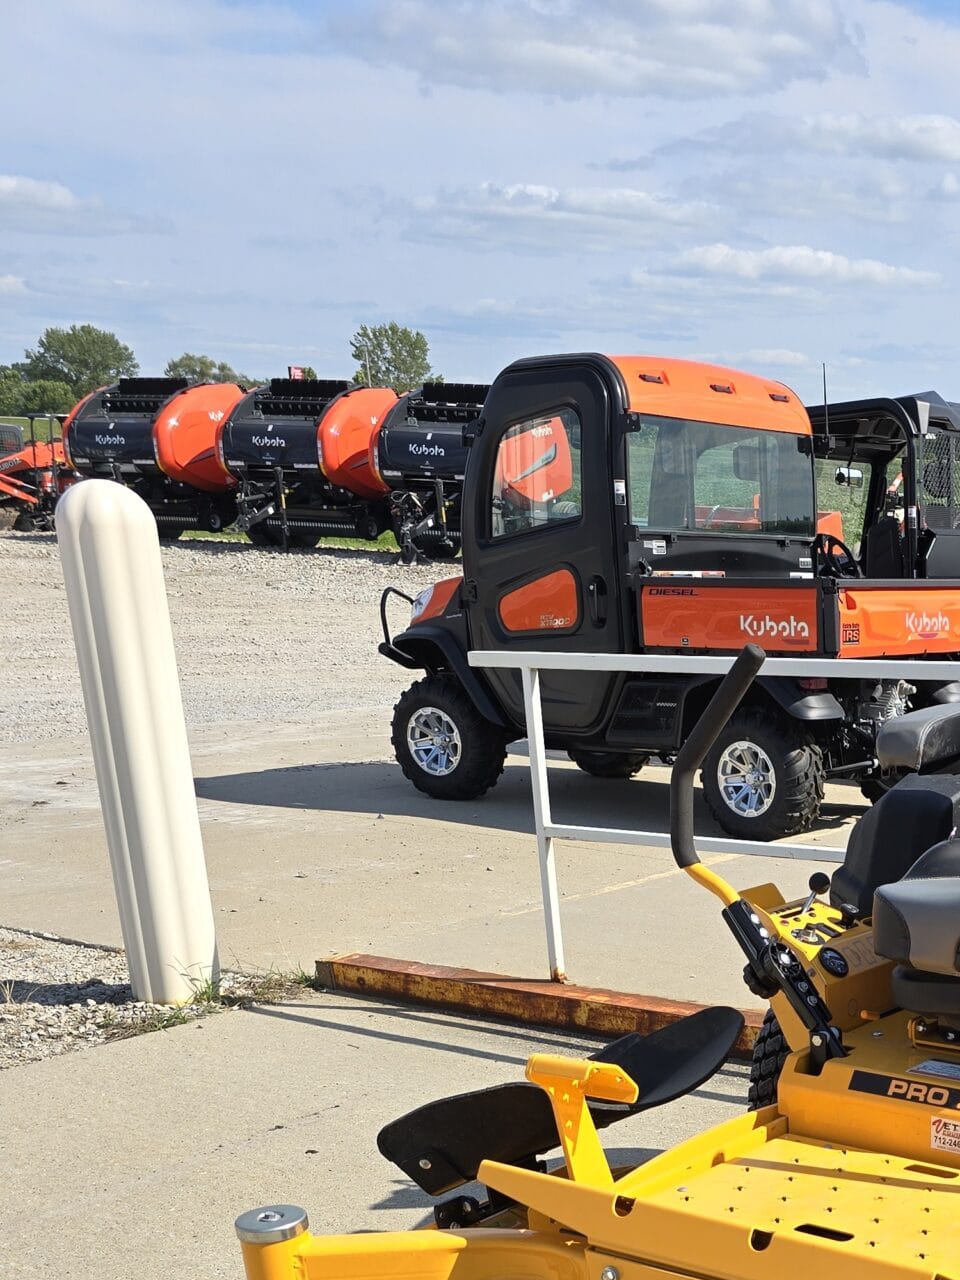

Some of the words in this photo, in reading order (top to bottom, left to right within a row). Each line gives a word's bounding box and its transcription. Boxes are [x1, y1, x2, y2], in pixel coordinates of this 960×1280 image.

[95, 434, 126, 446] Kubota
[252, 435, 286, 448] Kubota
[408, 443, 445, 457] Kubota
[648, 588, 699, 597] DIESEL
[739, 614, 810, 638] Kubota
[905, 611, 950, 633] Kubota
[843, 630, 859, 641] IRS
[887, 1079, 950, 1106] PRO
